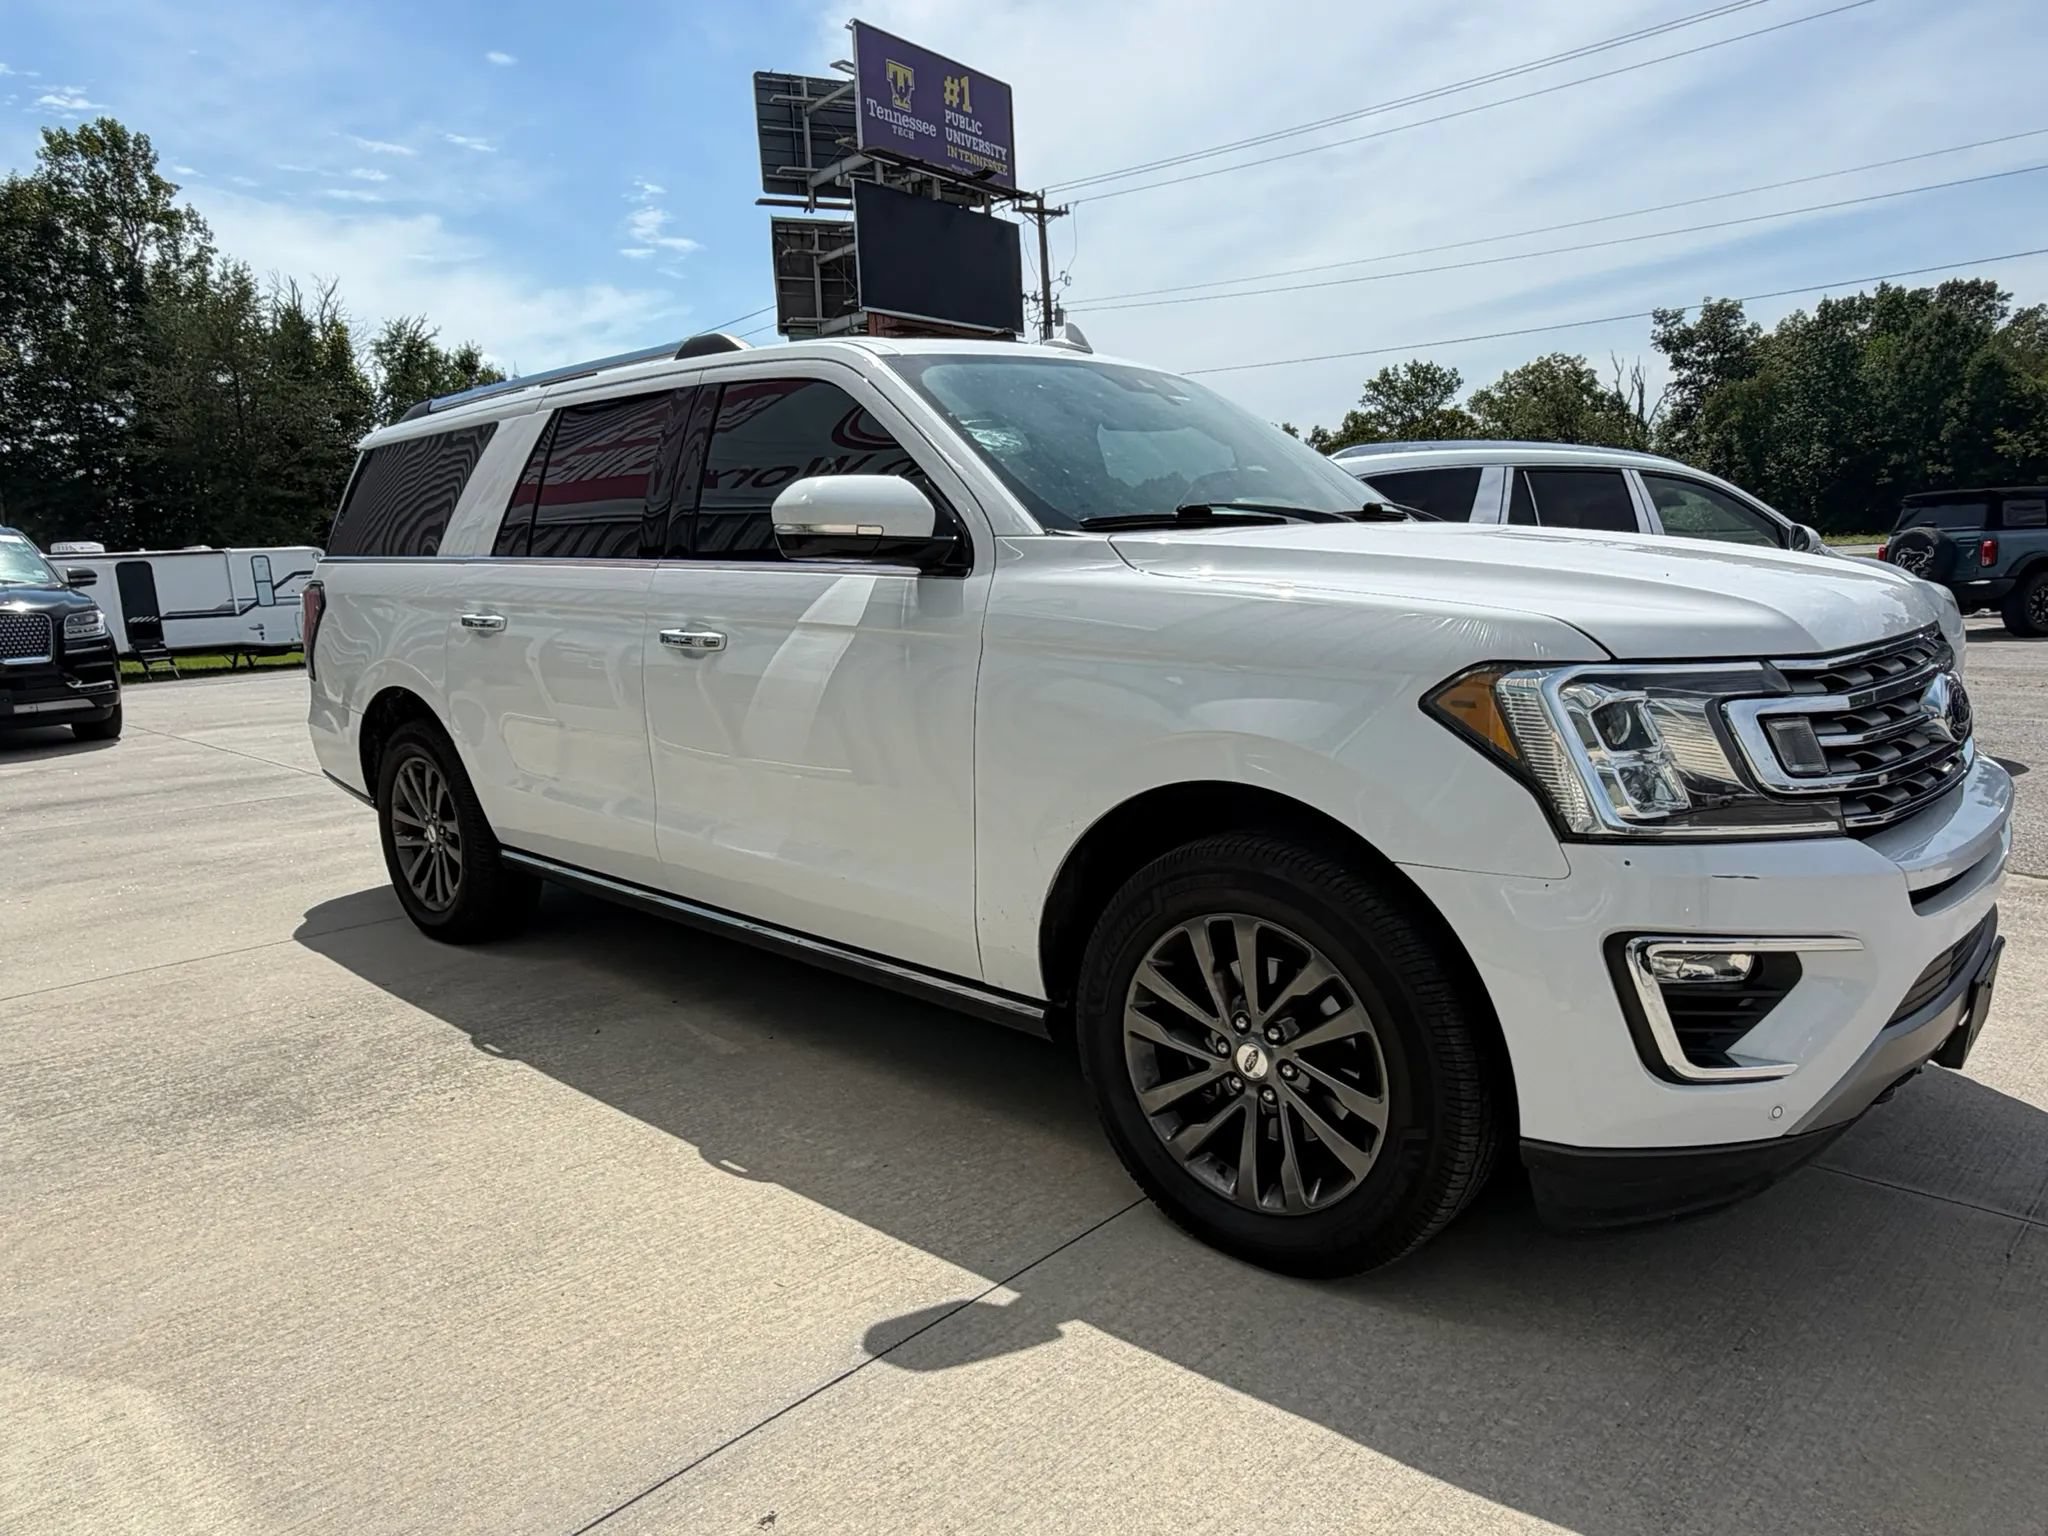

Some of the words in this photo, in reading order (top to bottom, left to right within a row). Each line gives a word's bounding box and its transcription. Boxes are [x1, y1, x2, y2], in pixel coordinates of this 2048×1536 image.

[944, 75, 973, 114] #1
[866, 97, 937, 138] Tennessee
[891, 124, 915, 140] TECH
[944, 109, 983, 136] PUBLIC
[944, 127, 1008, 161] UNIVERSITY
[946, 144, 958, 160] IN
